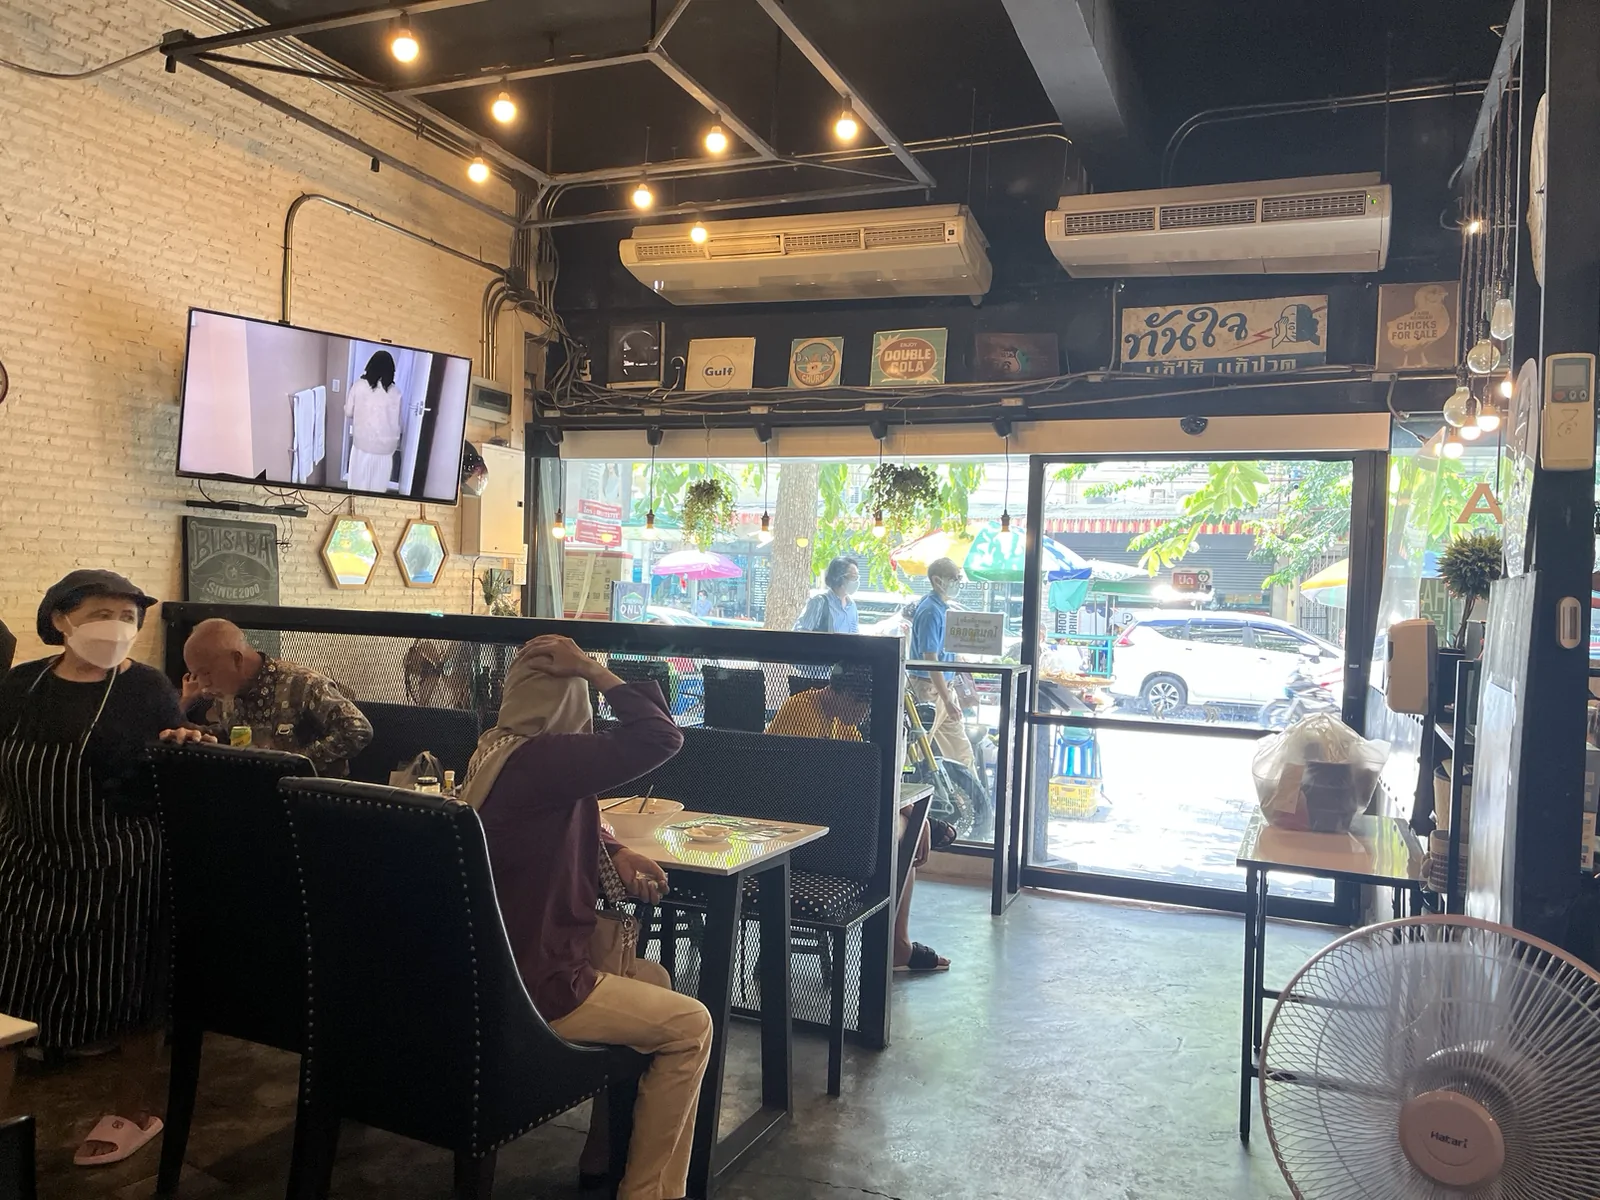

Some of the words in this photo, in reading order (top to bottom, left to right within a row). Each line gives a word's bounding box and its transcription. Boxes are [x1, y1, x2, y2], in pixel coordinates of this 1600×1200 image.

[1396, 320, 1437, 331] CHICKS
[1124, 306, 1249, 360] ทันใจ
[1391, 331, 1411, 340] FOR
[1413, 329, 1438, 340] SALE
[883, 348, 932, 362] DOUBLE
[704, 366, 734, 377] Gulf
[890, 360, 925, 373] COLA
[801, 373, 826, 384] CHURN
[206, 581, 239, 599] SINCE
[238, 583, 260, 599] 2000
[620, 604, 645, 616] ONLY
[1430, 1131, 1469, 1149] Hatari
